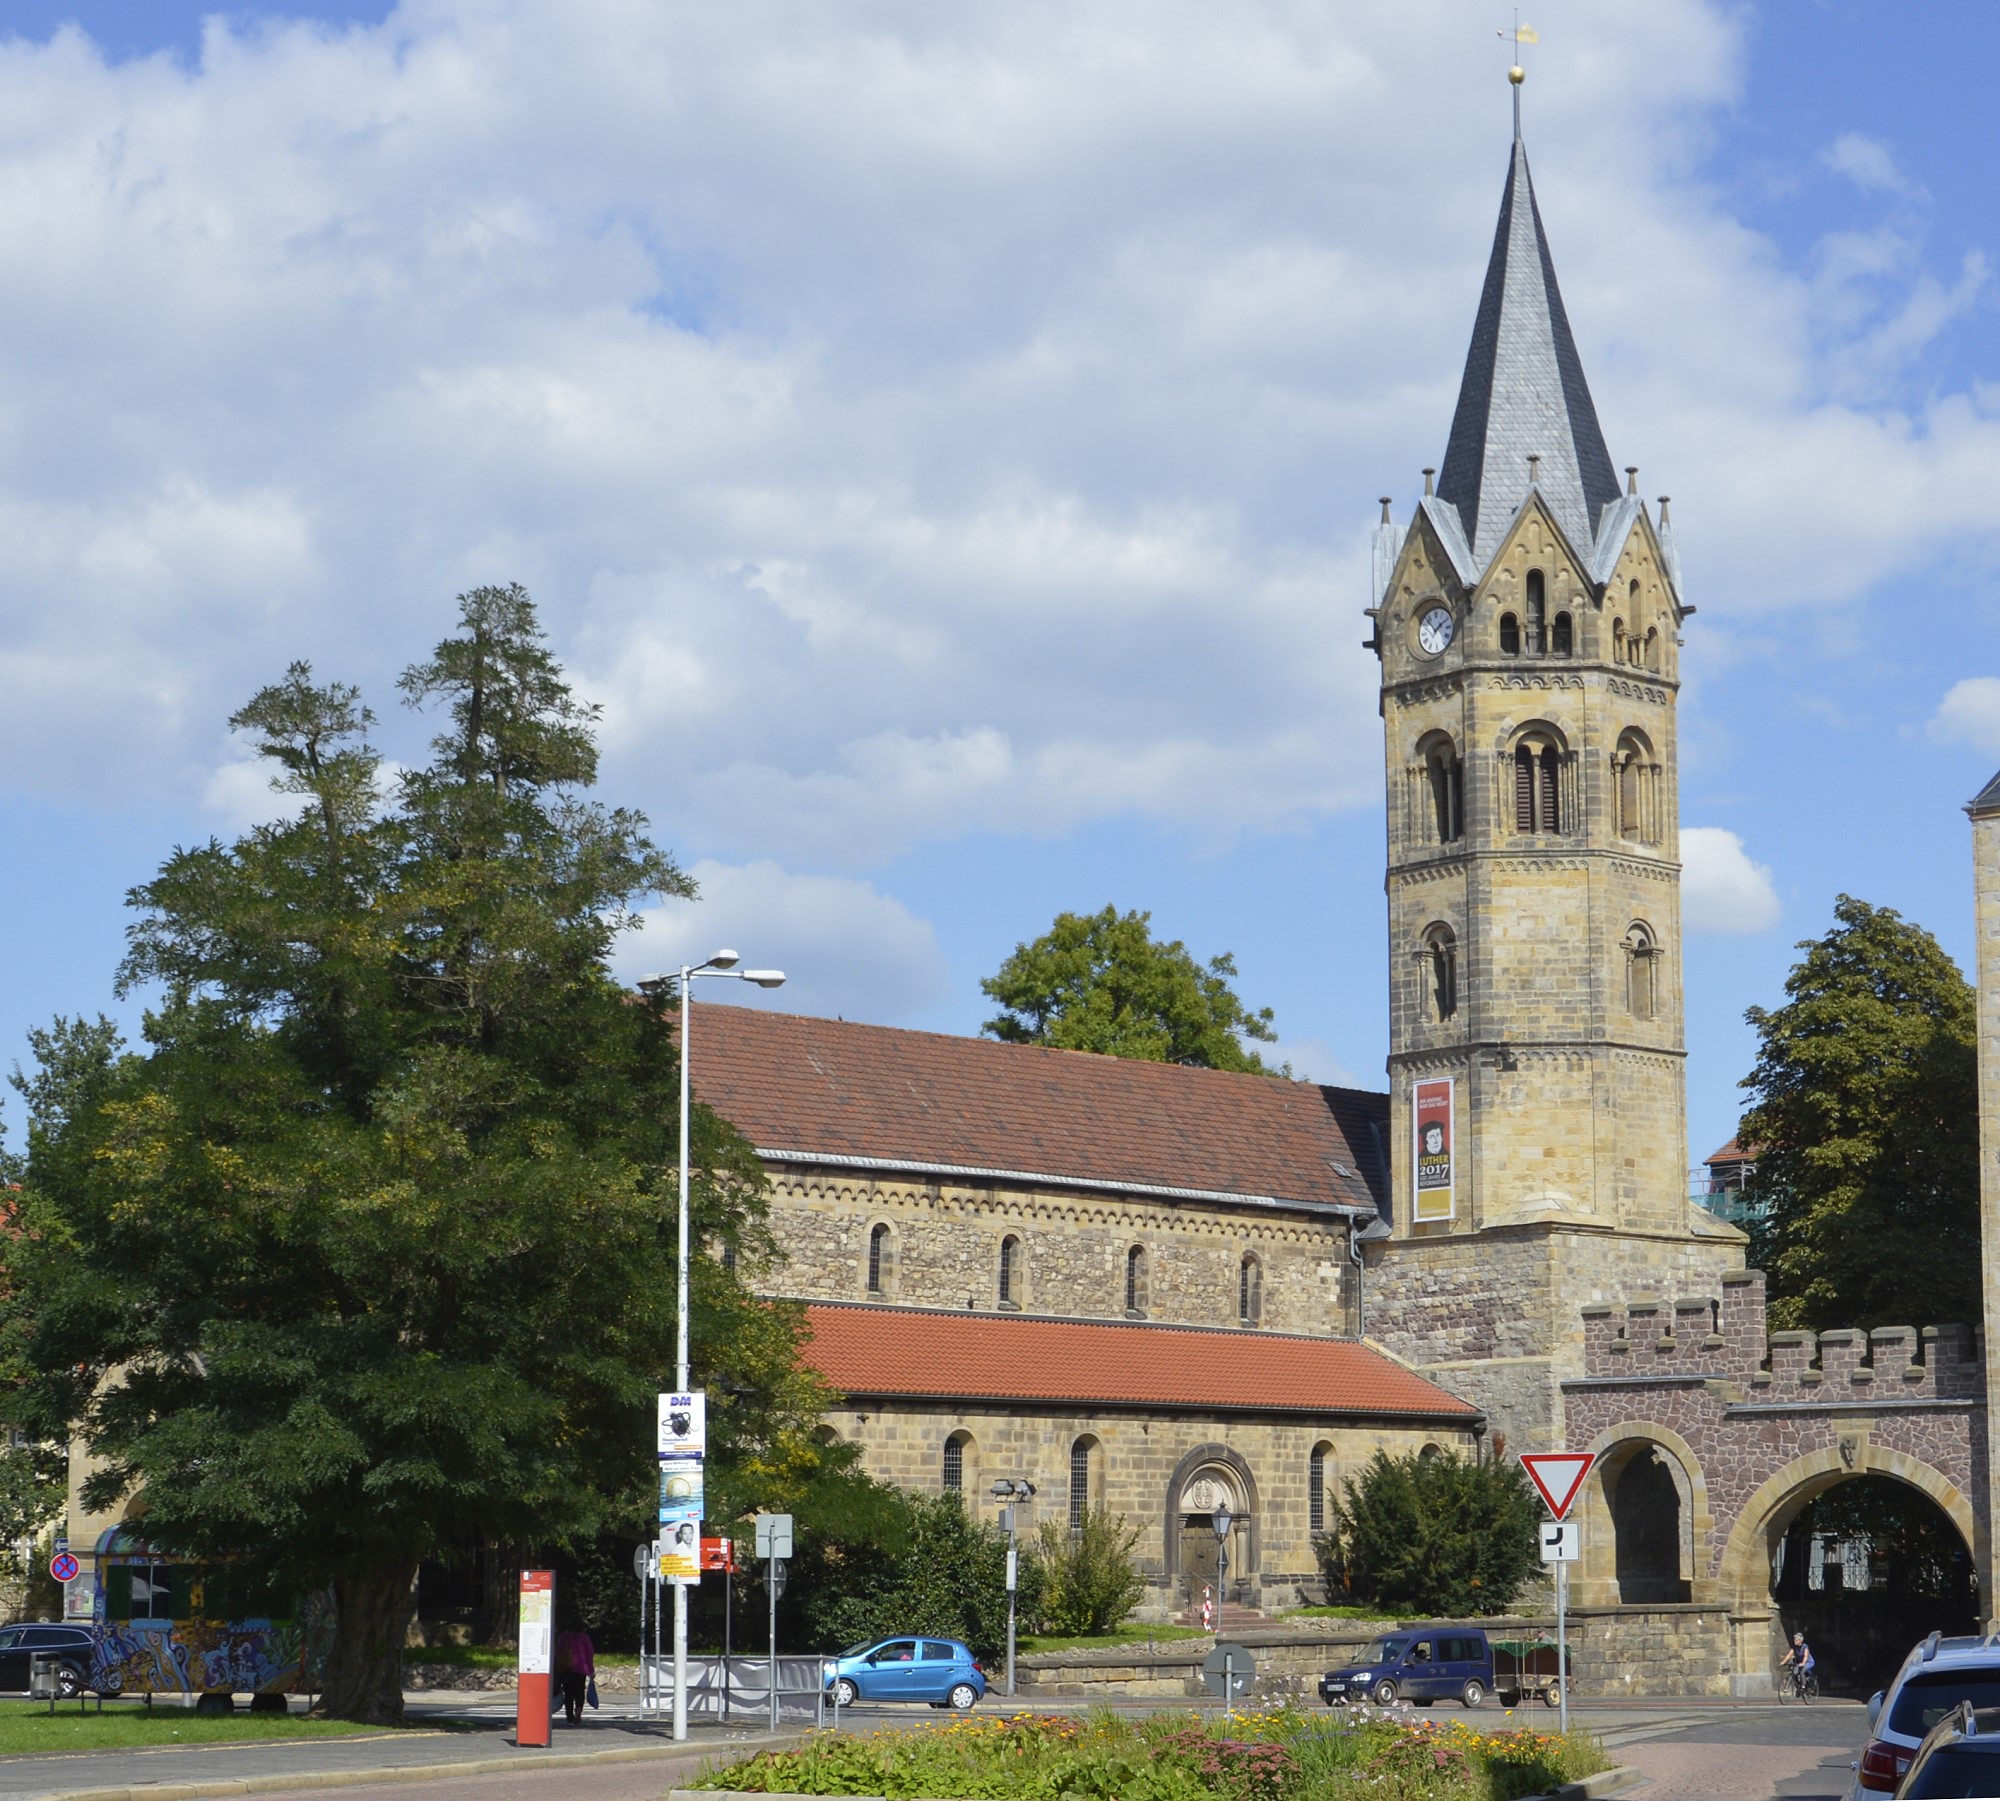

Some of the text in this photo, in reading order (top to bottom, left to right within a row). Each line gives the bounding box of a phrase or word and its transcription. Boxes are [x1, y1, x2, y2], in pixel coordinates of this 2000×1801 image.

[1419, 1154, 1449, 1166] LUTHER
[1419, 1164, 1449, 1179] 2017
[670, 1396, 691, 1406] DM
